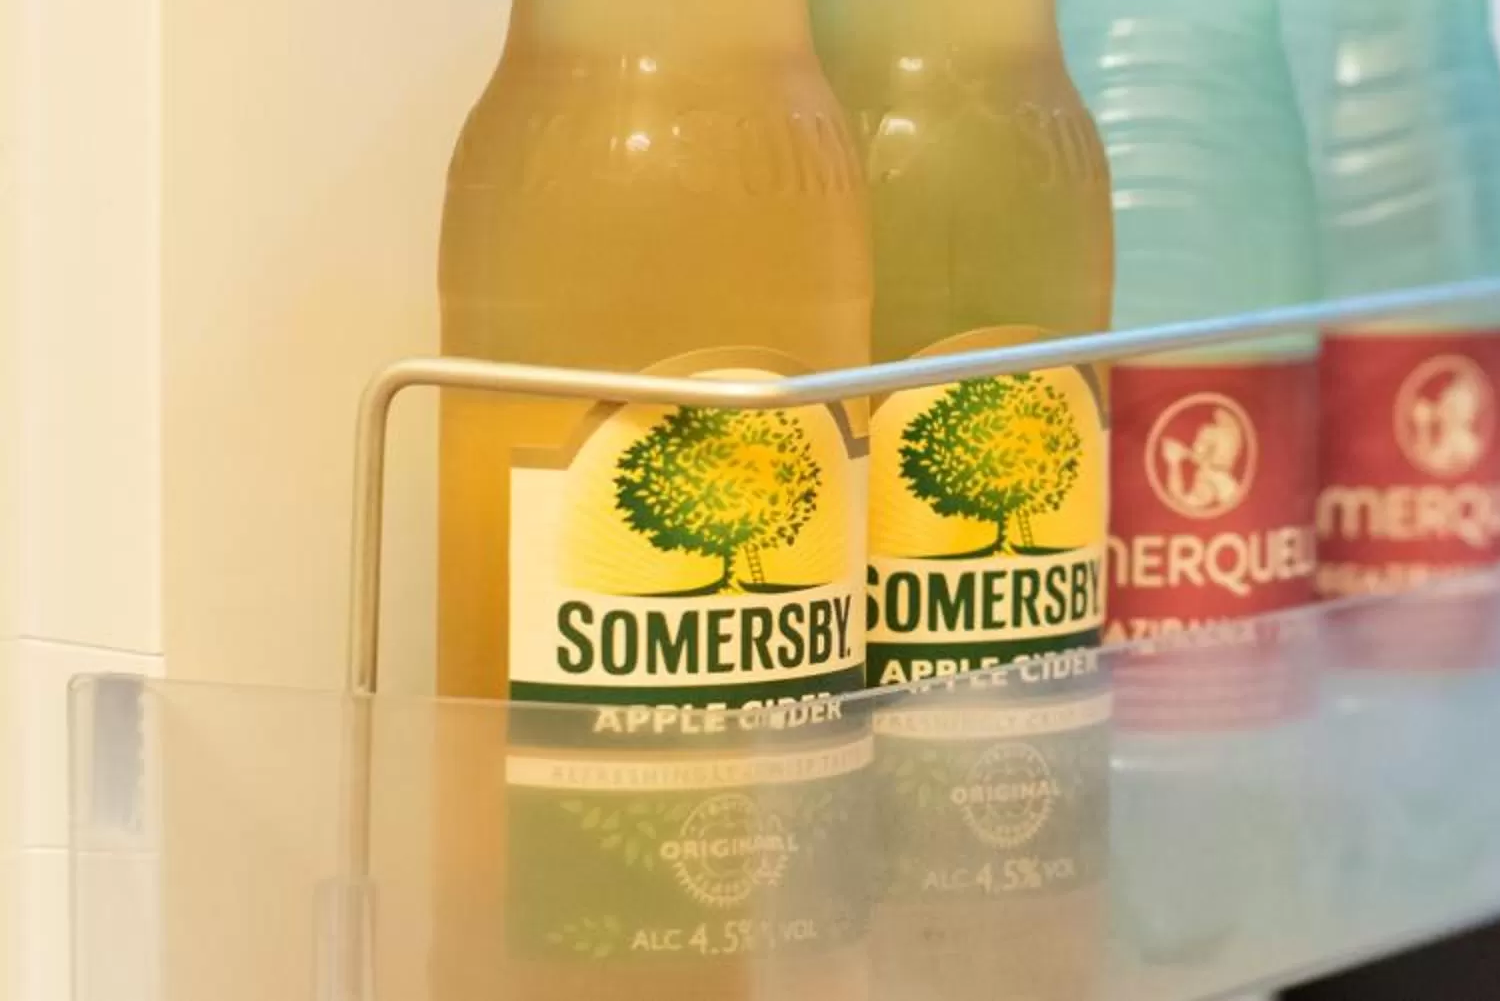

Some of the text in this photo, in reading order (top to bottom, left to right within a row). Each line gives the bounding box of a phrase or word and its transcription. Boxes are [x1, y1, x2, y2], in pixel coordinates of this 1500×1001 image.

[879, 646, 1100, 699] APPLE CIDER
[592, 702, 728, 734] APPLE
[738, 692, 845, 730] CIDER
[951, 777, 1062, 806] ORIGINAL
[659, 833, 799, 860] ORIGINAL
[631, 928, 684, 952] ALC
